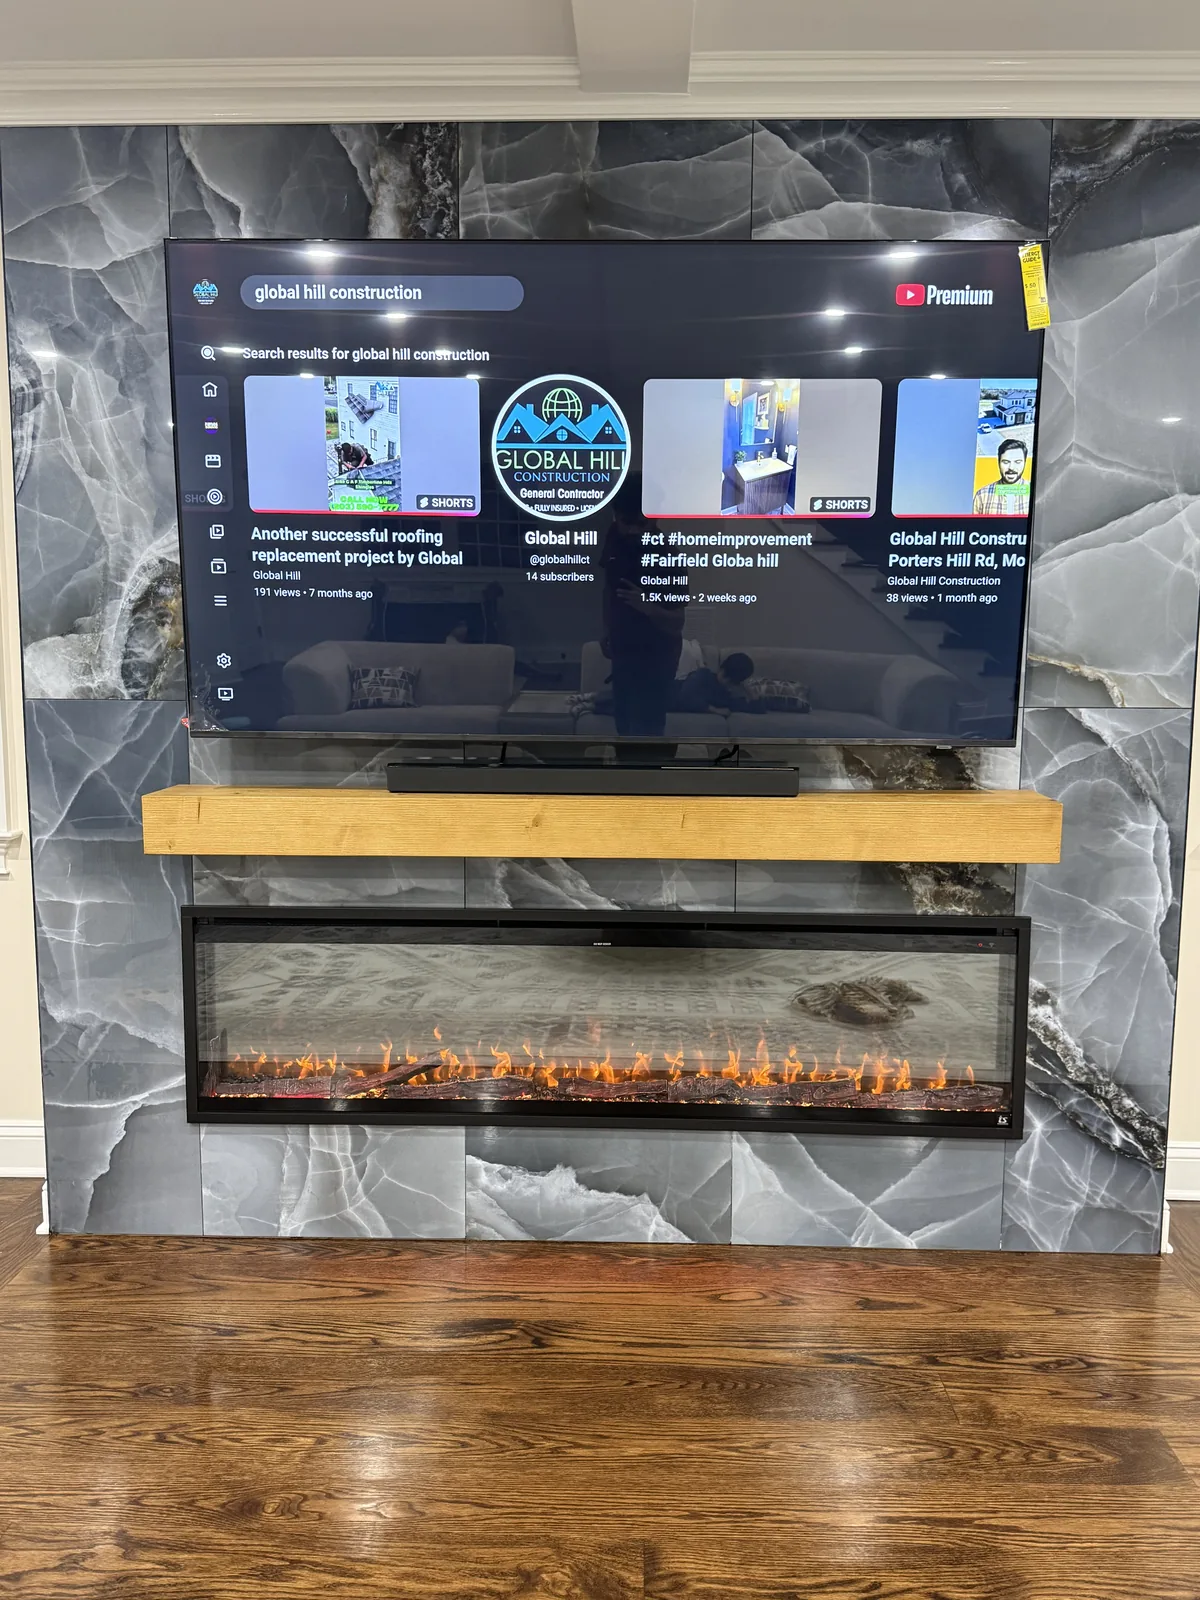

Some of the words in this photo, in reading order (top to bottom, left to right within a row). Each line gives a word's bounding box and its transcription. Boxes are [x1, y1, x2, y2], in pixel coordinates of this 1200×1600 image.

[255, 284, 299, 302] global
[304, 284, 325, 299] hill
[330, 285, 421, 299] construction
[927, 285, 993, 305] Premium
[242, 347, 284, 359] Search
[288, 347, 329, 359] results
[332, 347, 349, 359] for
[352, 348, 389, 362] global
[393, 348, 410, 360] hill
[414, 348, 489, 361] construction
[497, 450, 583, 470] GLOBAL
[514, 472, 610, 483] CONSTRUCTION
[185, 494, 226, 503] SHOS
[520, 488, 555, 499] General
[557, 488, 605, 499] Contractor
[431, 498, 474, 509] SHORTS
[534, 504, 550, 512] FULLY
[551, 504, 576, 512] INSURED
[825, 500, 869, 511] SHORTS
[251, 527, 308, 540] Another
[312, 528, 388, 542] successful
[392, 529, 442, 546] roofing
[525, 531, 569, 544] Global
[574, 531, 597, 545] Hill
[641, 532, 664, 545] #ct
[668, 532, 812, 549] #homeimprovement
[890, 531, 936, 545] Global
[941, 531, 965, 545] Hill
[969, 532, 1026, 545] Constru
[253, 548, 341, 563] replacement
[344, 550, 394, 567] project
[398, 550, 414, 567] by
[418, 551, 462, 564] Global
[530, 555, 589, 566] @globalhillct
[641, 553, 708, 567] #Fairfield
[713, 554, 753, 567] Globa
[757, 553, 778, 567] hill
[889, 554, 942, 567] Porters
[947, 553, 971, 567] Hill
[975, 553, 998, 569] Rd,
[1003, 554, 1025, 567] Mo
[253, 570, 282, 580] Global
[286, 570, 300, 581] Hill
[527, 571, 537, 581] 14
[540, 571, 594, 582] subscribers
[641, 575, 670, 586] Global
[673, 575, 687, 586] Hill
[888, 575, 917, 586] Global
[921, 575, 936, 586] Hill
[939, 576, 1000, 586] Construction
[255, 587, 270, 597] 191
[274, 587, 300, 597] views
[309, 588, 315, 598] 7
[317, 588, 352, 599] months
[355, 590, 373, 601] ago
[641, 592, 661, 602] 1.5K
[664, 592, 690, 602] views
[699, 592, 704, 603] 2
[707, 592, 736, 603] weeks
[739, 594, 757, 605] ago
[887, 593, 898, 603] 38
[901, 593, 928, 603] views
[938, 593, 942, 603] 1
[946, 592, 976, 603] month
[979, 594, 997, 605] ago
